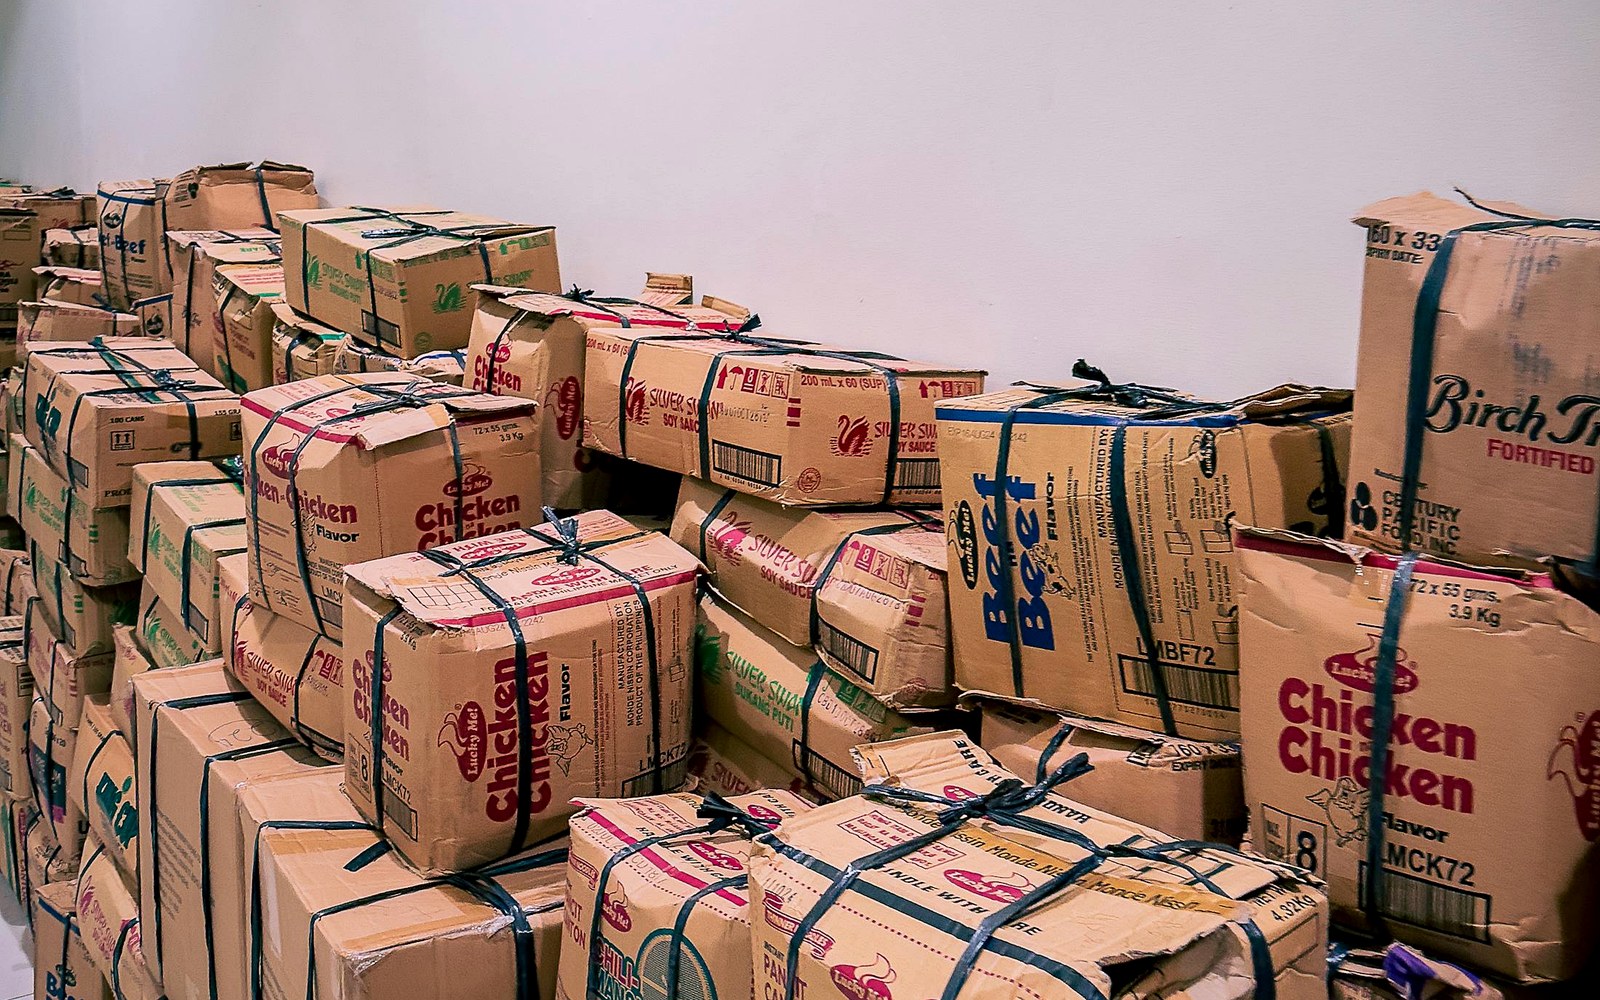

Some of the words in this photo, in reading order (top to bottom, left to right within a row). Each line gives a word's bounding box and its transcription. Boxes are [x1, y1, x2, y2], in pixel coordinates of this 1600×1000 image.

[475, 355, 521, 392] Chcken
[800, 374, 818, 387] 200
[821, 376, 836, 388] mL
[836, 379, 844, 388] x
[846, 377, 858, 388] 60
[650, 387, 684, 414] SILVER
[1425, 374, 1547, 442] Birch
[663, 413, 678, 428] SOY
[874, 420, 913, 439] SILER
[908, 441, 936, 453] SAUCE
[1487, 438, 1595, 475] FORTIFIED
[1045, 471, 1058, 541] Flavor
[1095, 446, 1108, 538] MANUFACTURED
[1382, 490, 1461, 523] CETURY
[415, 494, 520, 532] Chcken
[961, 507, 972, 533] Me!
[316, 522, 360, 544] Flavor
[749, 533, 797, 572] SILVER
[962, 534, 976, 583] Lucky
[1005, 475, 1056, 651] Beef
[510, 586, 563, 603] ANDLE
[565, 575, 609, 589] WITH
[760, 565, 778, 584] SOY
[779, 575, 813, 600] SAUCE
[1429, 583, 1438, 594] x
[1443, 582, 1461, 598] 55
[613, 603, 624, 617] BY:
[1449, 604, 1472, 620] 3.9
[1476, 607, 1501, 628] Kg
[623, 601, 634, 663] CORPORATION
[615, 619, 625, 690] MANUFACTURED
[634, 653, 644, 670] THE
[625, 667, 635, 693] NISSIN
[634, 672, 644, 685] OF
[725, 650, 767, 693] SILVER
[559, 664, 571, 722] Flavor
[634, 688, 644, 727] PRODUCT
[467, 707, 479, 732] Me!
[626, 695, 635, 727] MONDE
[486, 657, 518, 823] Chicken
[527, 651, 552, 814] Chicken
[360, 755, 369, 782] 8
[467, 734, 481, 776] Lucky
[986, 845, 1039, 869] Monde
[937, 891, 989, 915] WITH
